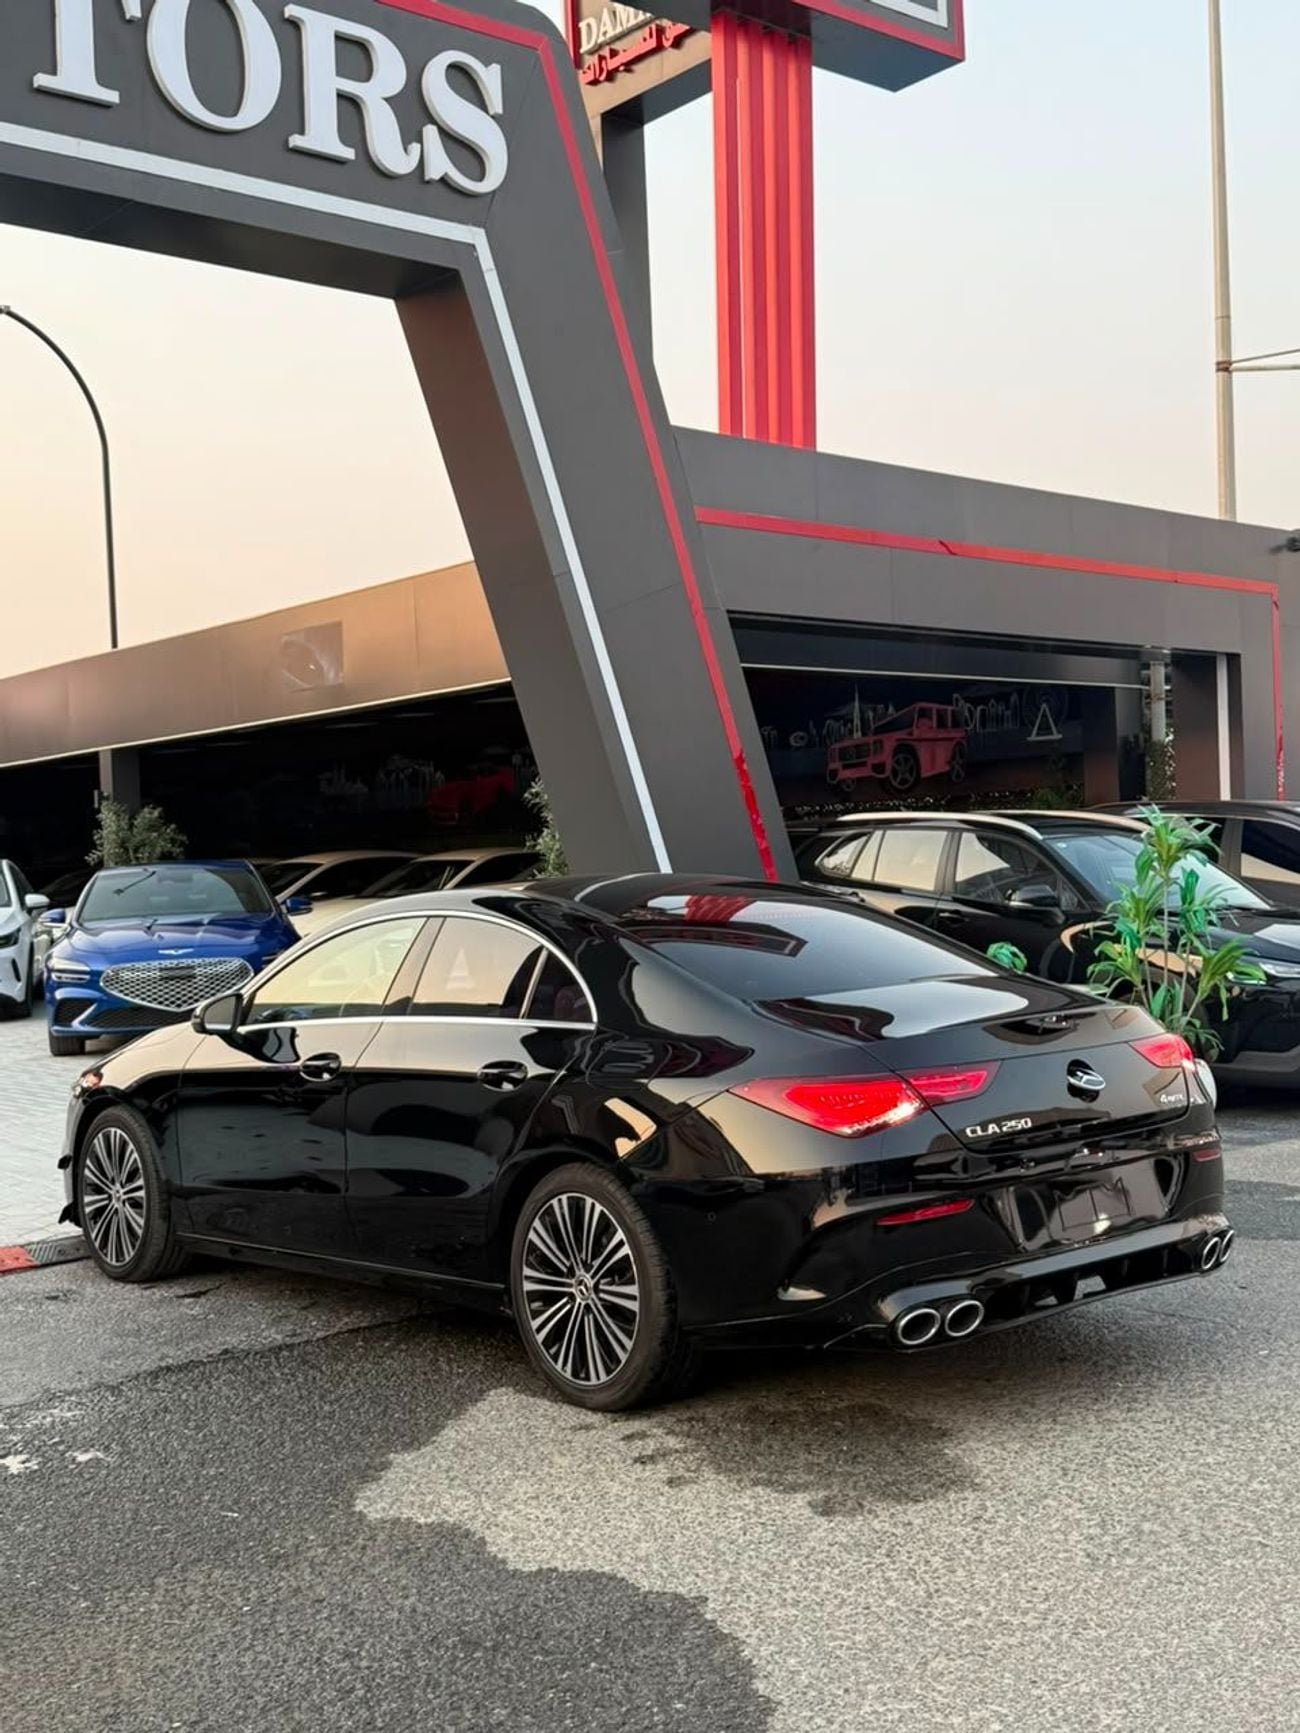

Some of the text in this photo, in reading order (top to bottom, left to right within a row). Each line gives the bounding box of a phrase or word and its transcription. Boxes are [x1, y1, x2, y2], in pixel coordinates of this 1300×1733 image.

[578, 2, 655, 54] DAM
[965, 1117, 1032, 1138] CLA 250
